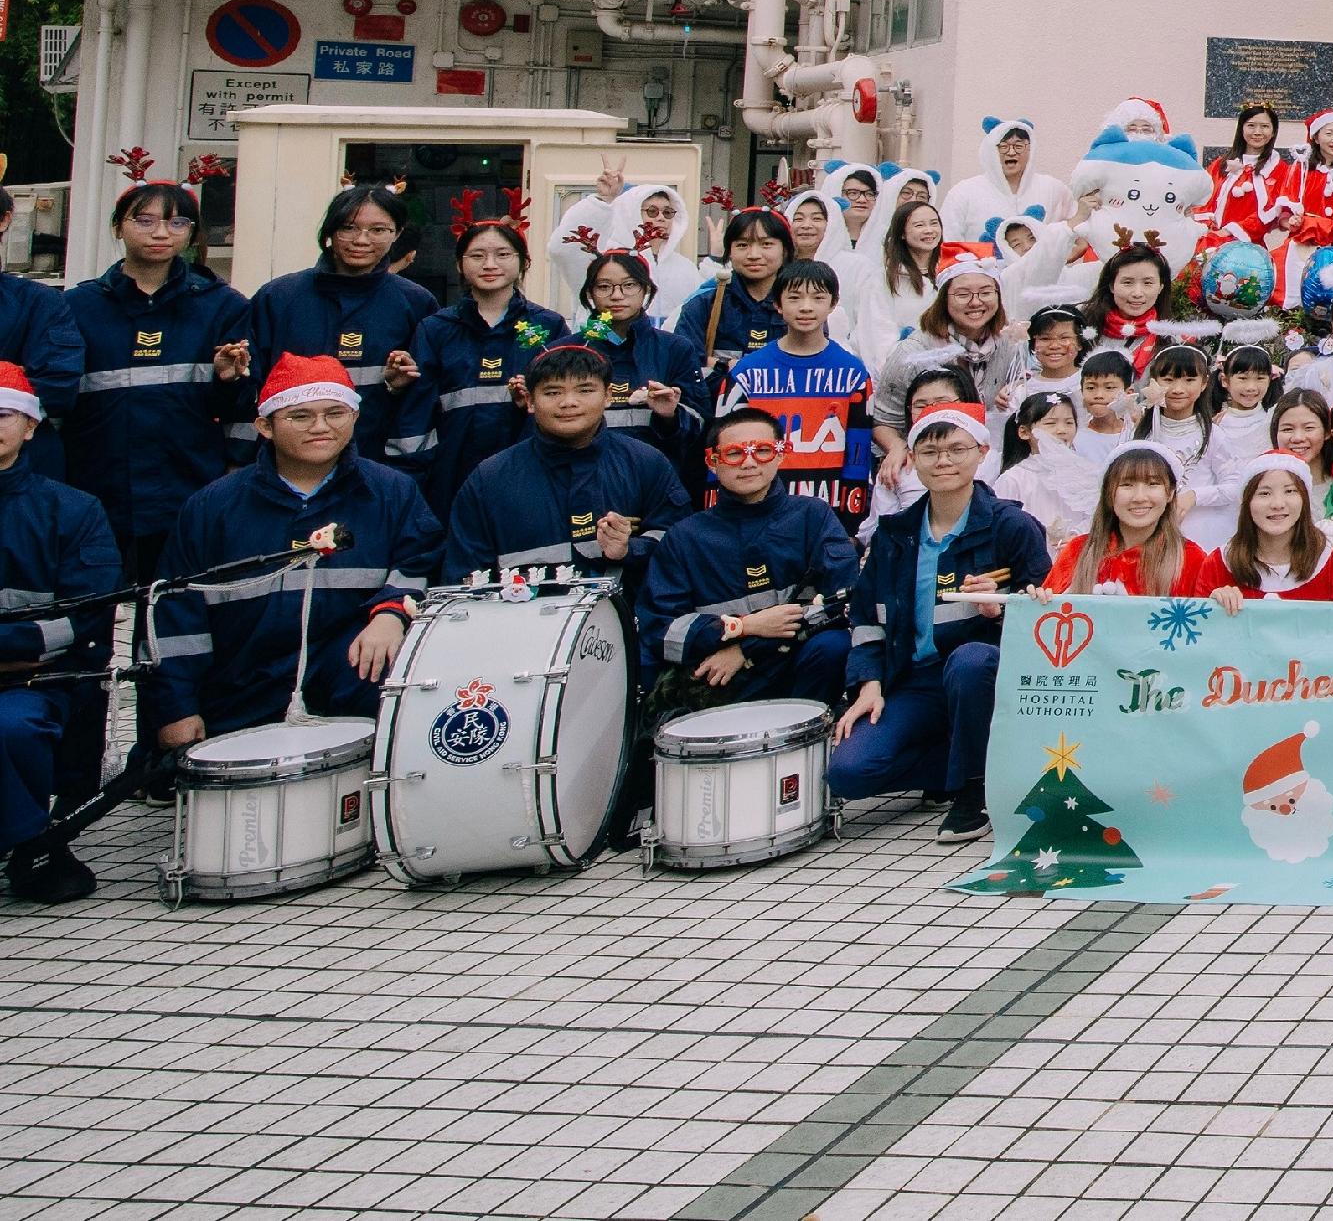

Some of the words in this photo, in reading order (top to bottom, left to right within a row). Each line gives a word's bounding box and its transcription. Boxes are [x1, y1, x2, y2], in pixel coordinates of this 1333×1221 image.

[319, 45, 368, 57] Private
[376, 48, 412, 58] Road
[332, 59, 395, 76] 私家路
[226, 78, 277, 90] Except
[206, 90, 236, 100] with
[246, 91, 294, 103] permit
[1020, 675, 1097, 687] 醫院管理局
[1117, 667, 1187, 716] The
[1019, 695, 1095, 705] HOSPITAL
[1017, 706, 1094, 717] AUTHORITY
[433, 727, 441, 746] CIVIL
[436, 745, 448, 757] AID
[479, 741, 500, 759] HONG
[446, 753, 479, 764] SERVICE
